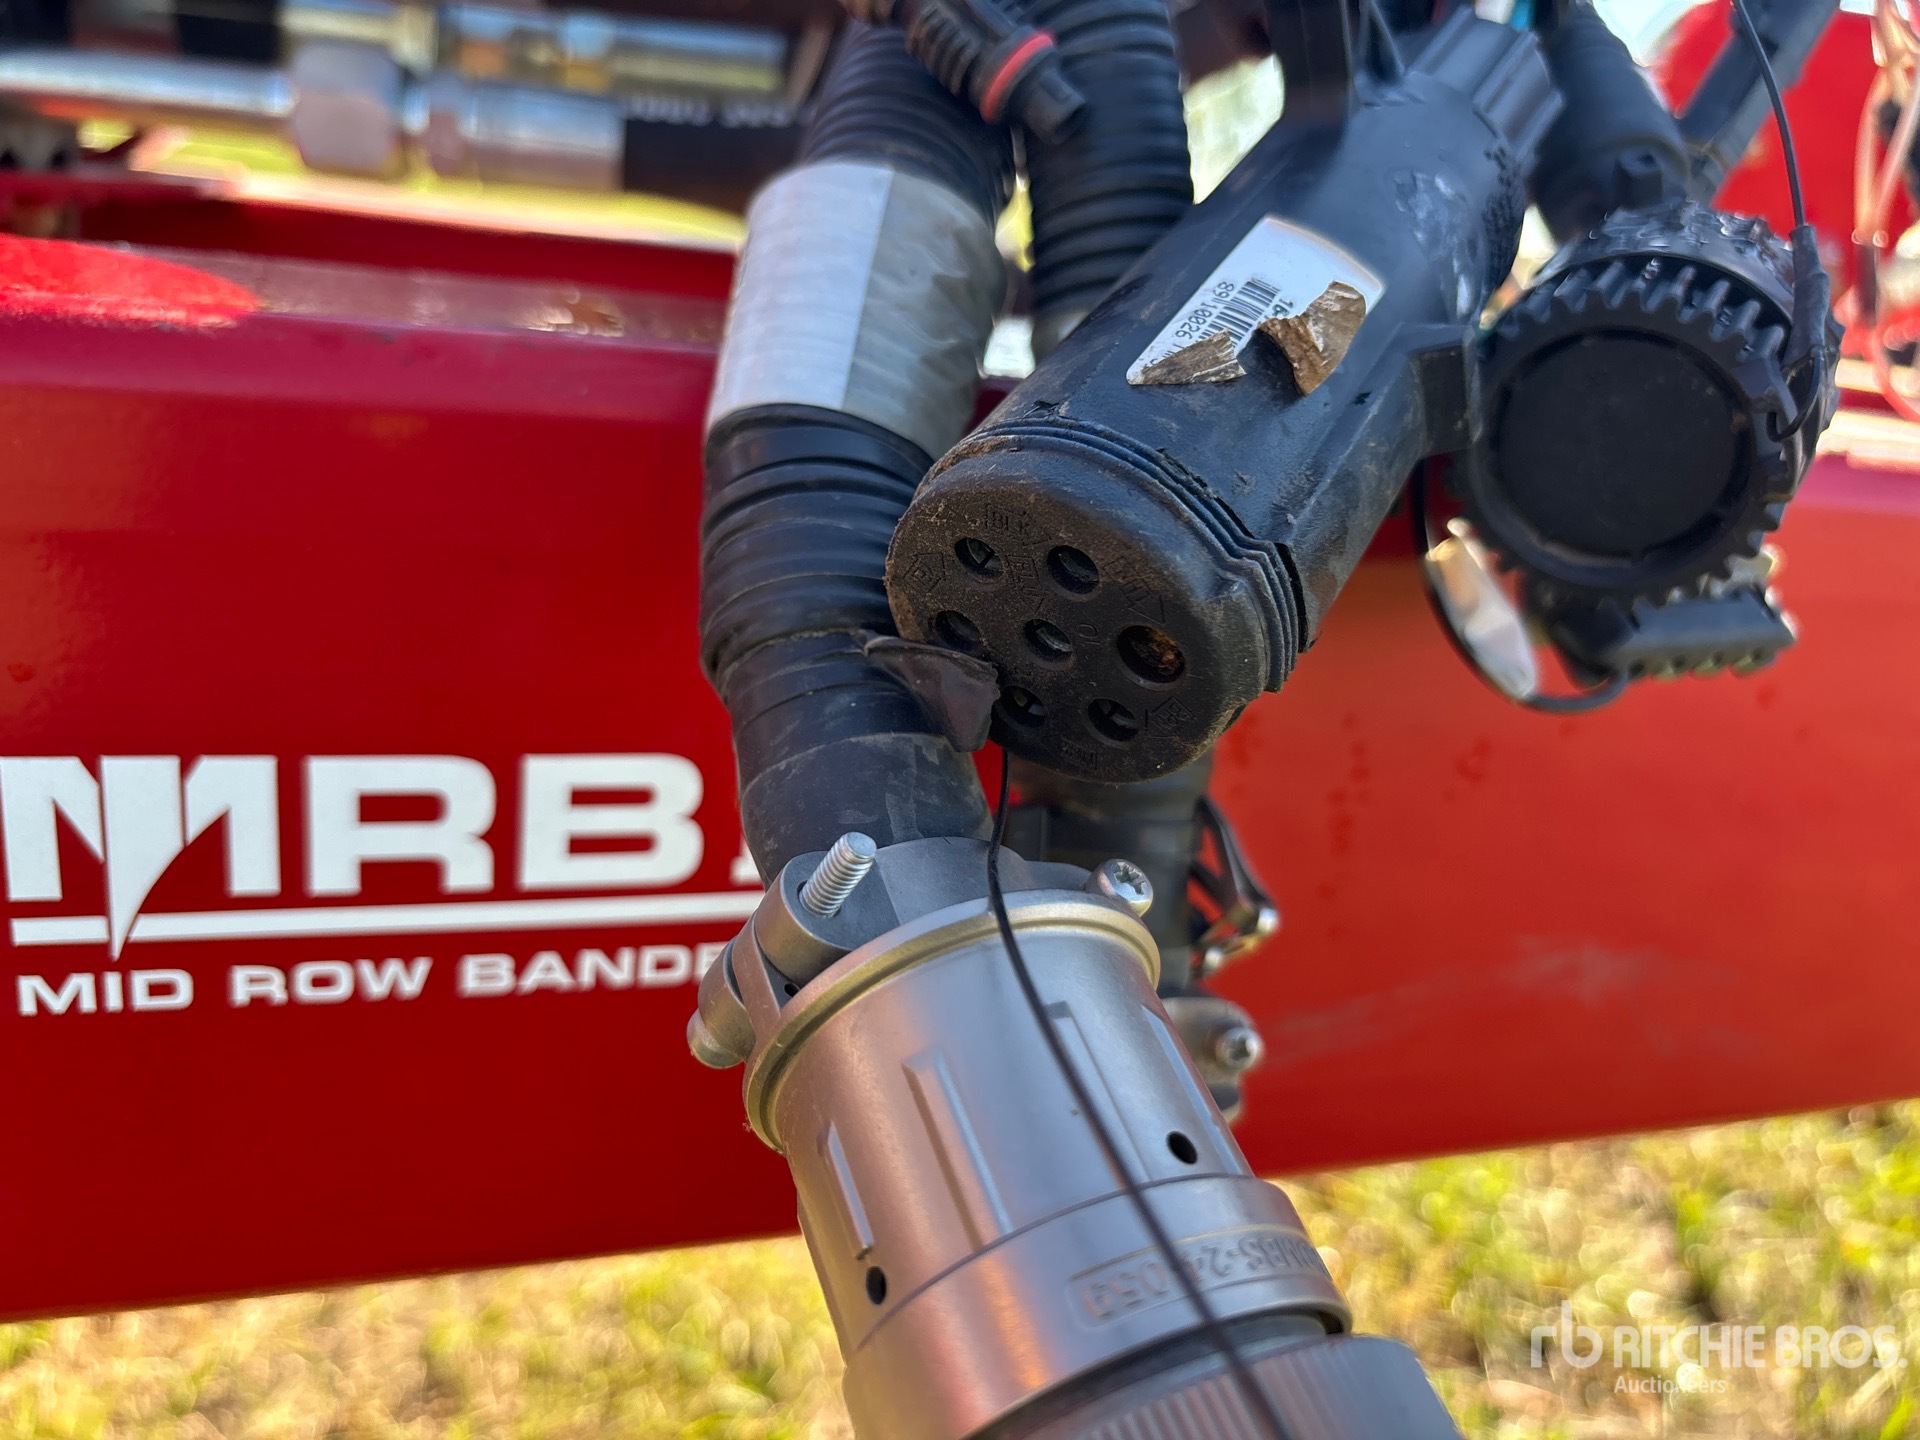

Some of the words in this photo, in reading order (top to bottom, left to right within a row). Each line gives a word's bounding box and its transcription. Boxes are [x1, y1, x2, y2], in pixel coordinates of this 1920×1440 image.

[0, 753, 703, 960] MRB
[17, 968, 194, 1016] MID
[229, 957, 432, 1007] ROW
